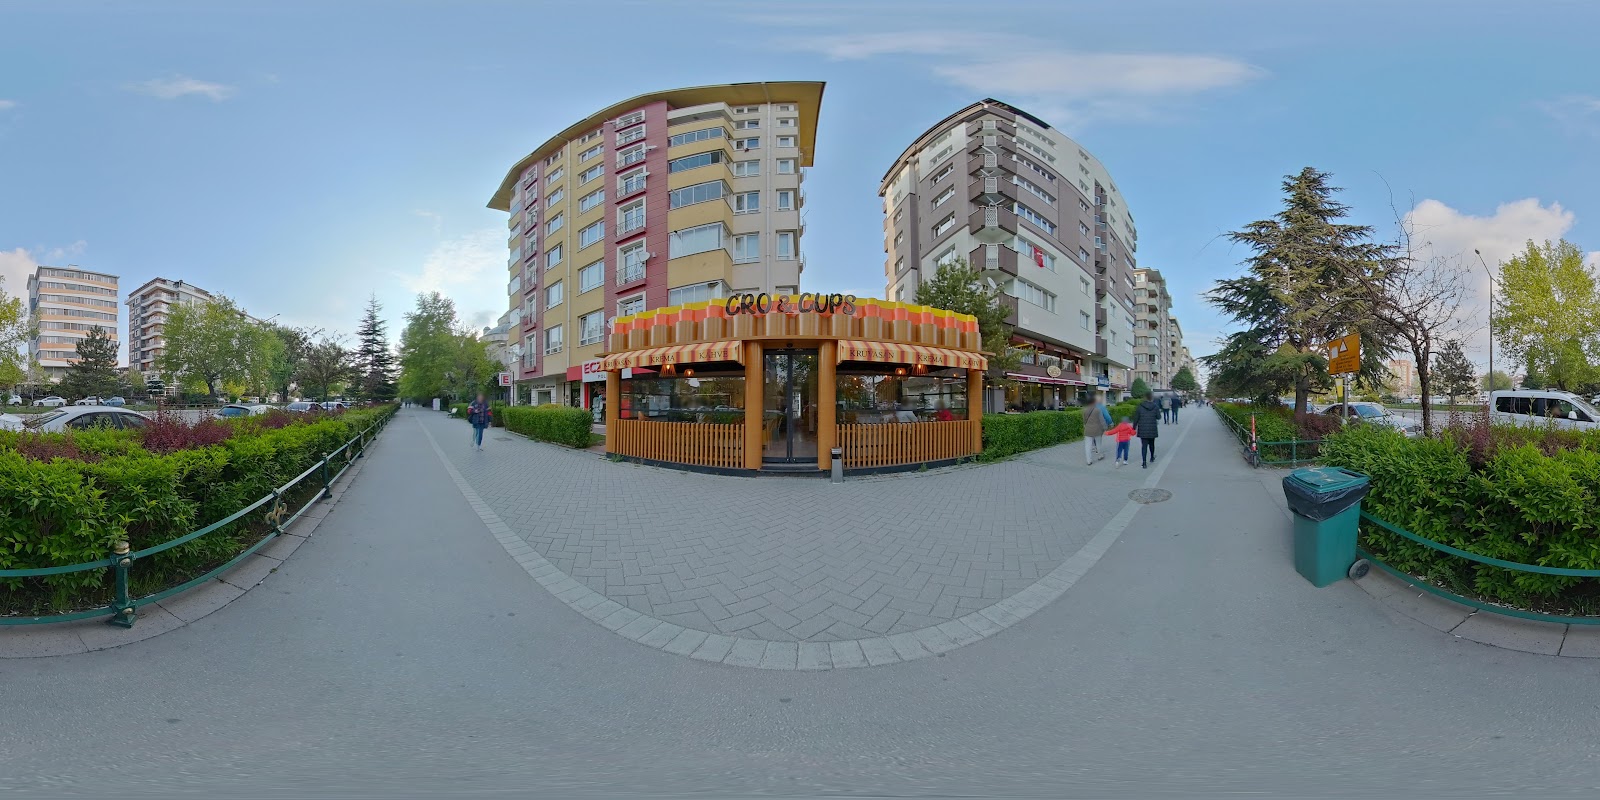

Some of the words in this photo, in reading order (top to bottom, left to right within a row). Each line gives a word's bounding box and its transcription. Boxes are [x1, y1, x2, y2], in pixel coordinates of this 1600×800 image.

[725, 292, 772, 316] CRO
[777, 294, 794, 314] &
[798, 292, 857, 316] CUPS
[650, 354, 675, 364] KREMA
[699, 350, 728, 359] KAHVE
[917, 354, 943, 363] KREMA
[962, 358, 983, 367] KAHV
[502, 375, 509, 383] E
